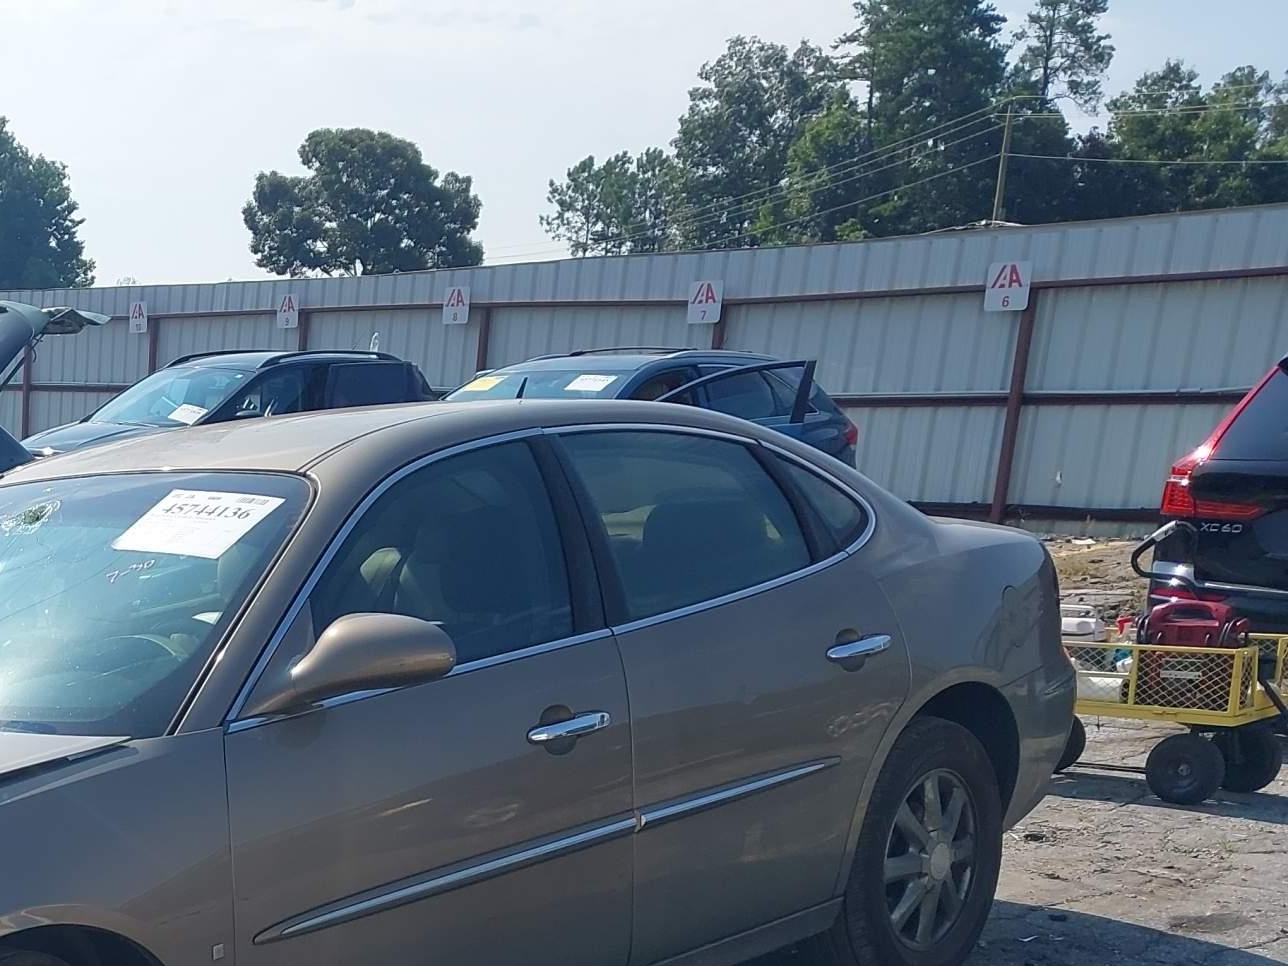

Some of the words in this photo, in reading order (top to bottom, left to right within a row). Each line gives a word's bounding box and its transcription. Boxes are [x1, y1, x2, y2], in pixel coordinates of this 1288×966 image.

[1002, 295, 1010, 307] 6
[700, 310, 707, 321] 7
[162, 503, 255, 520] 45744136
[1200, 522, 1243, 533] XC60
